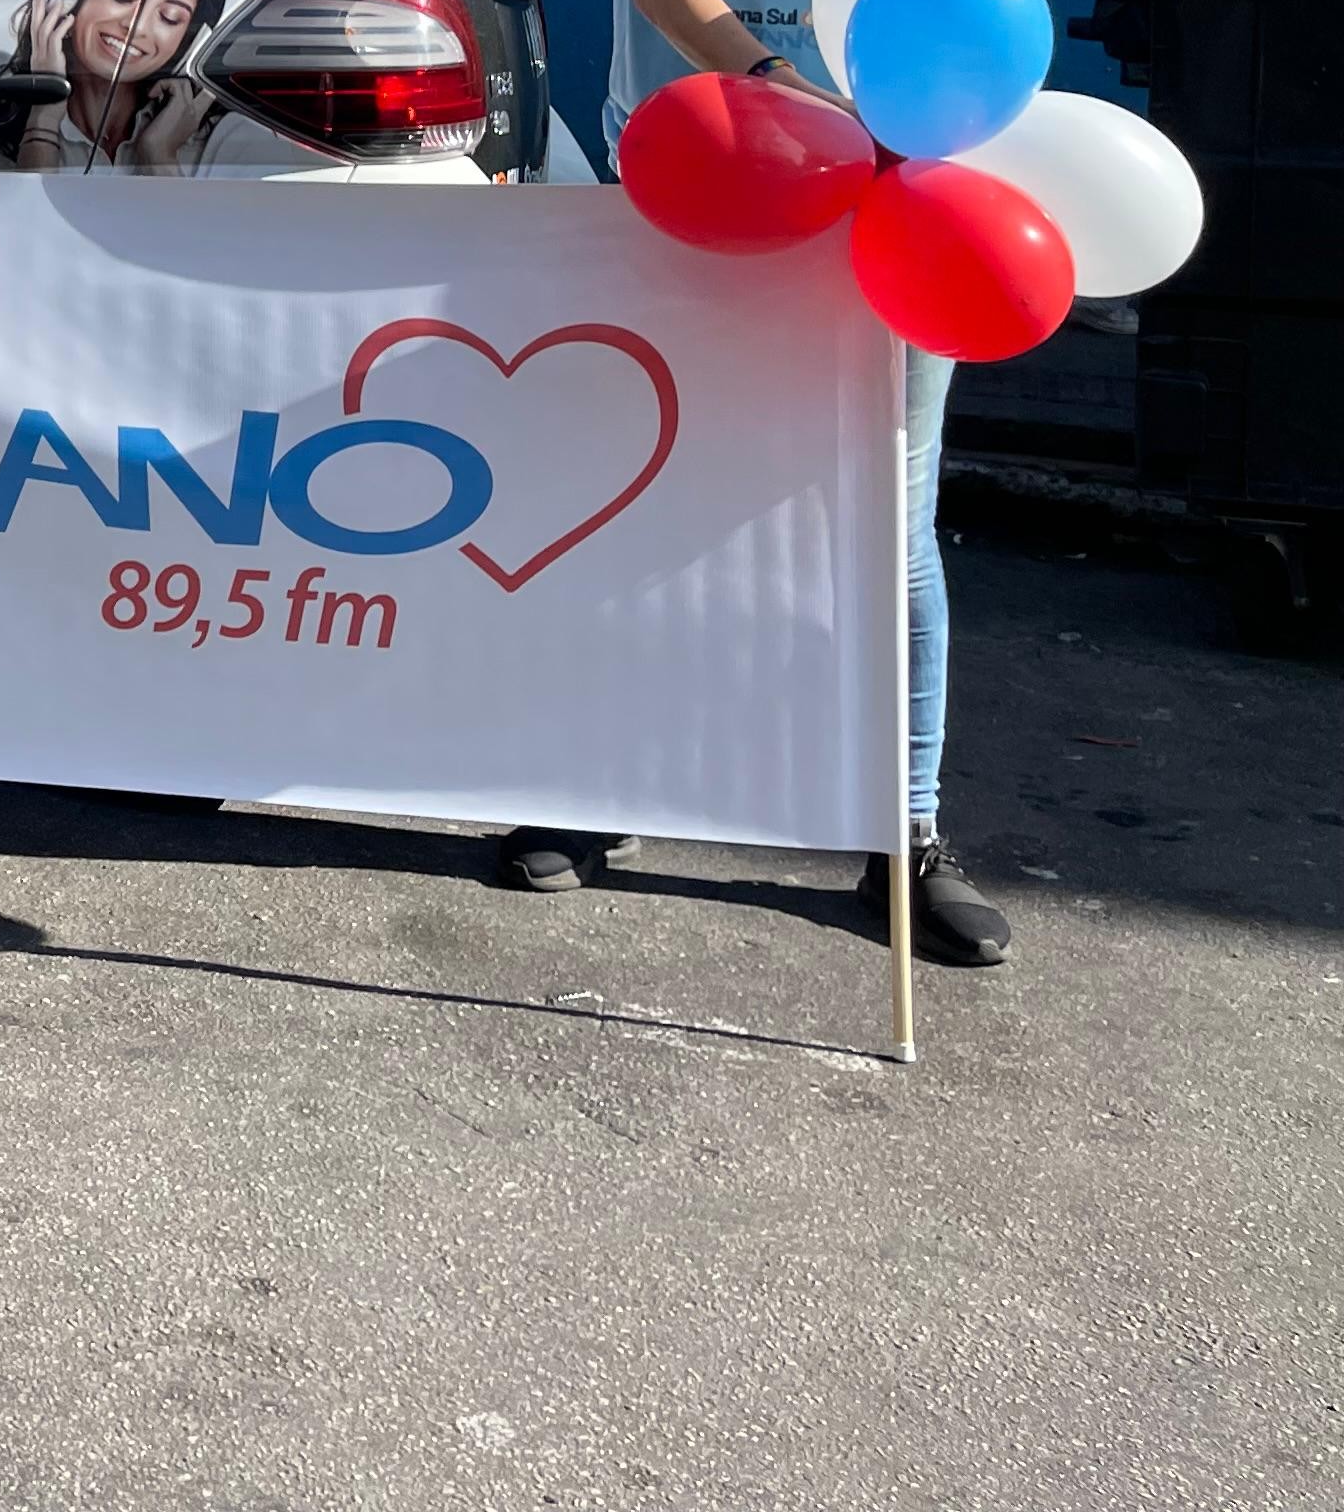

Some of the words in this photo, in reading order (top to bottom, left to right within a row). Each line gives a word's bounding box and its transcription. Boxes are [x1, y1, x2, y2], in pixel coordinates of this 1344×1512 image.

[766, 8, 798, 25] Sul
[101, 560, 270, 649] 89,5
[285, 567, 398, 649] fm
